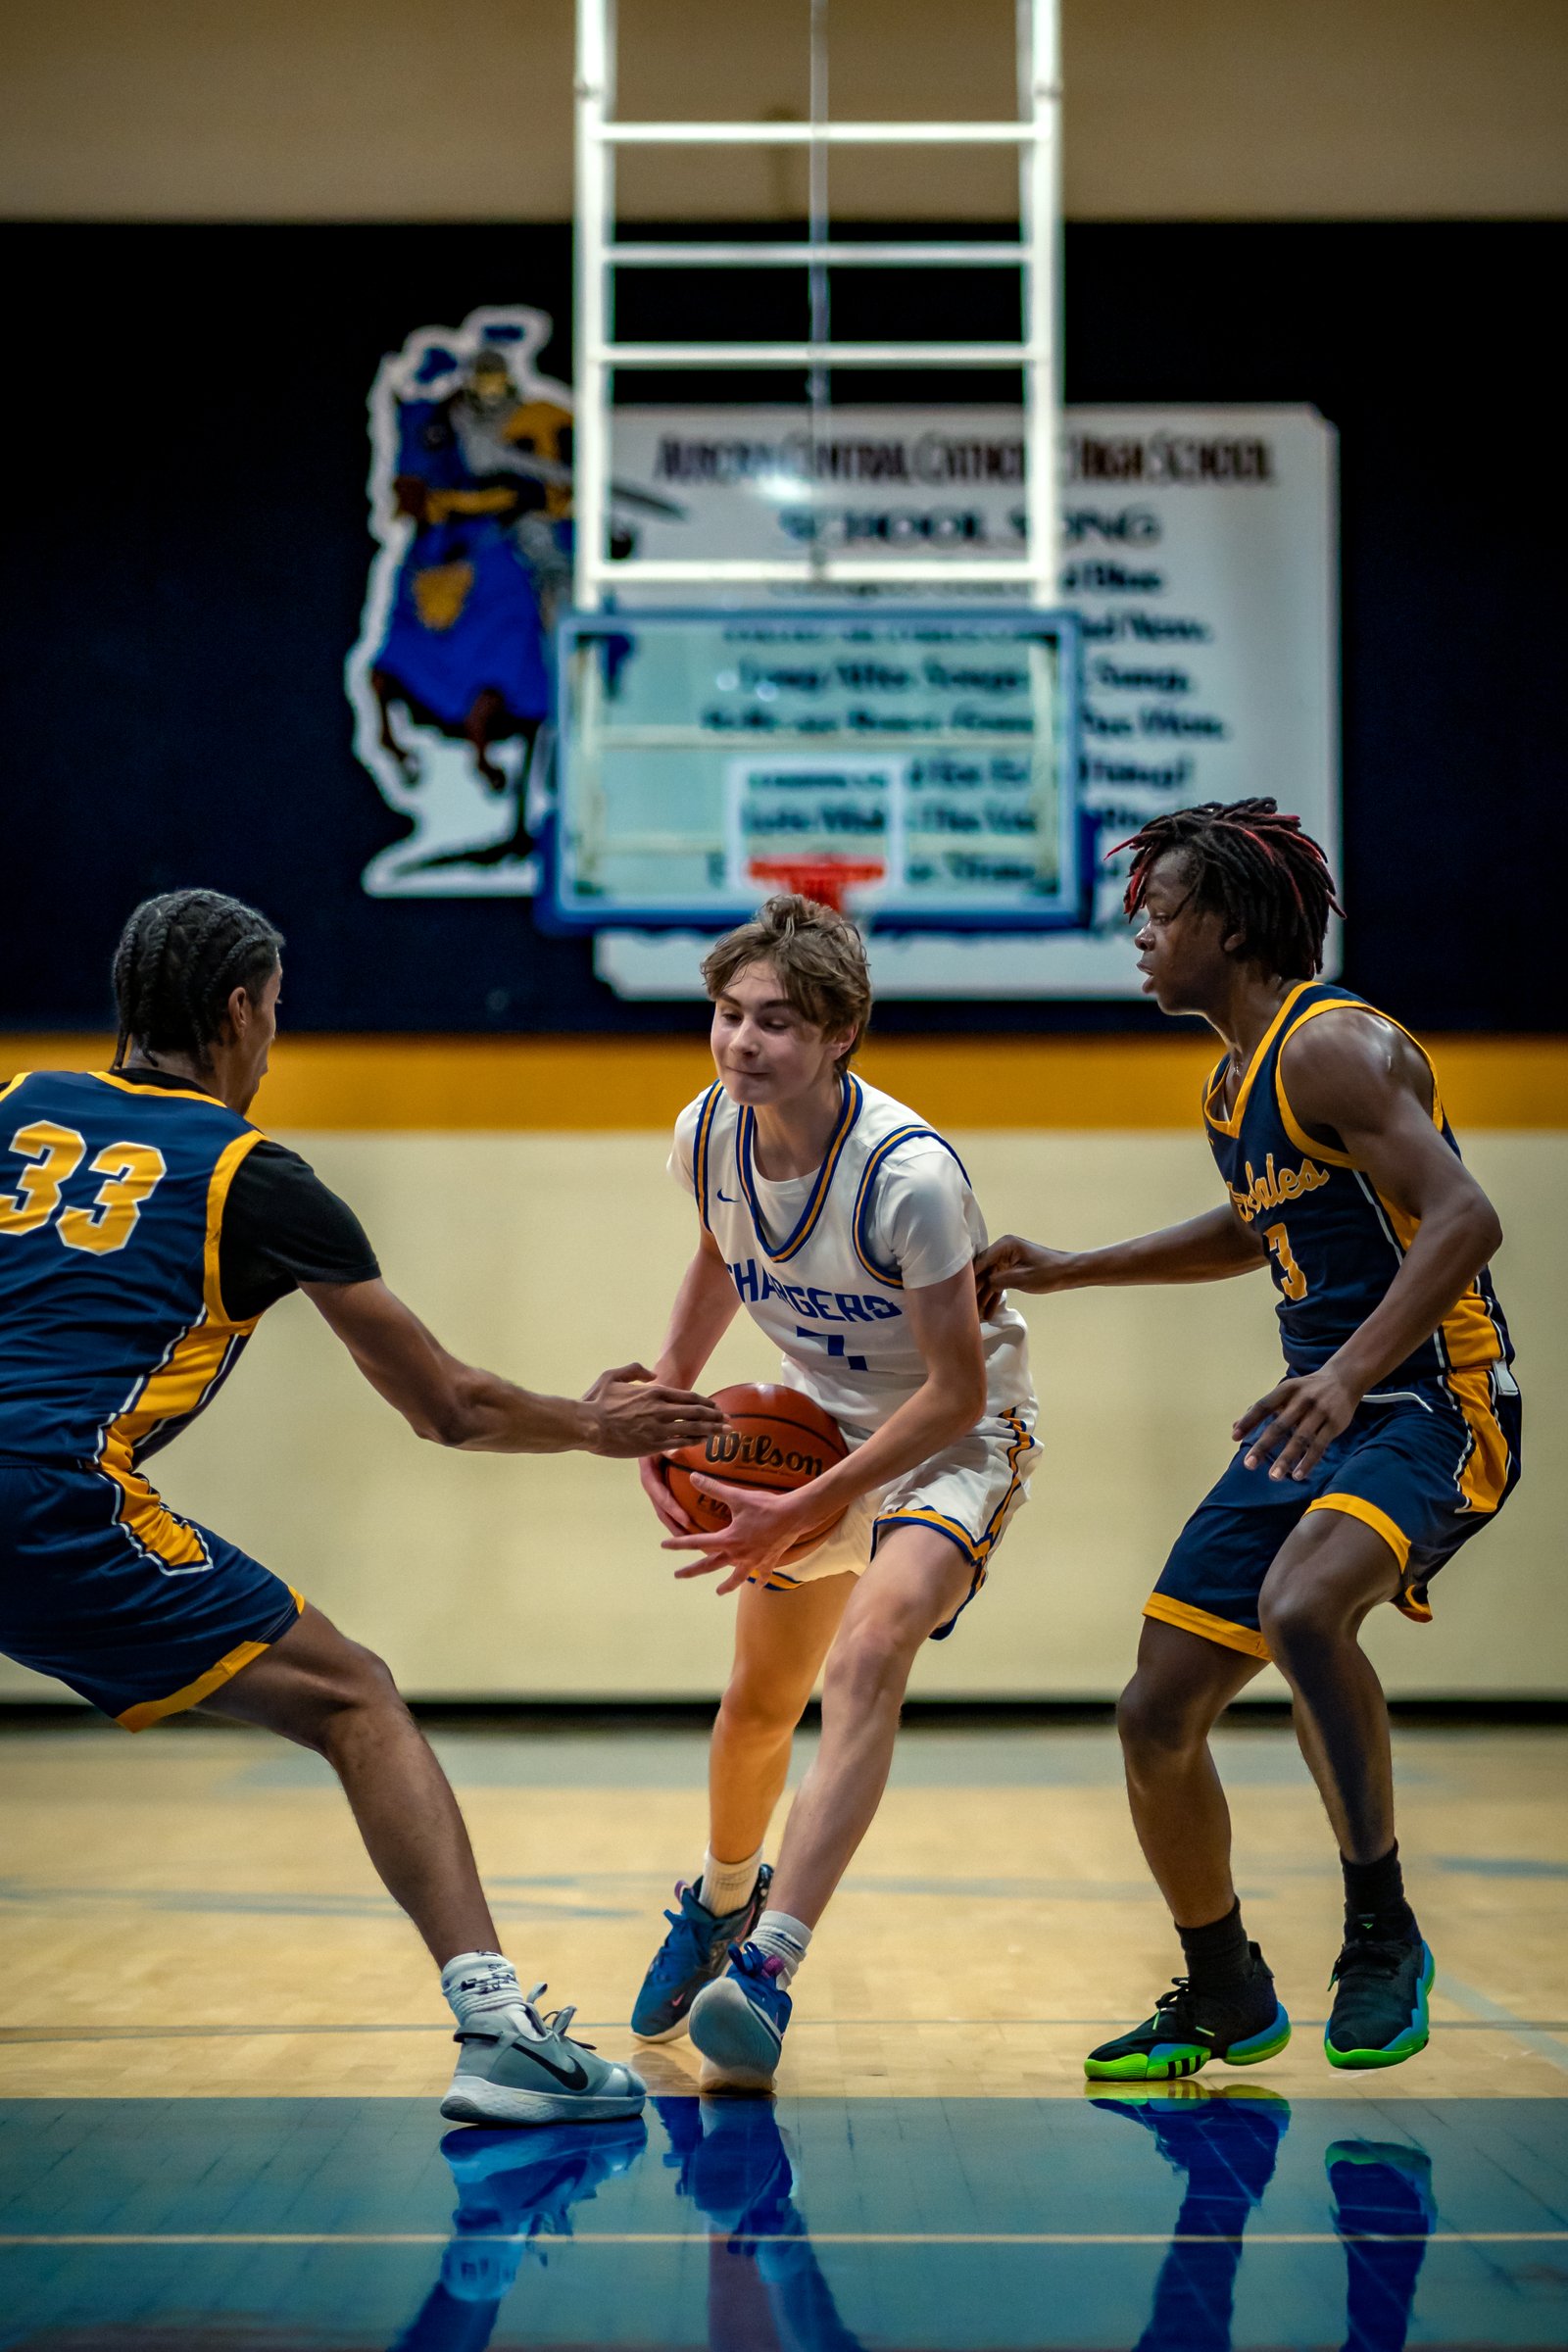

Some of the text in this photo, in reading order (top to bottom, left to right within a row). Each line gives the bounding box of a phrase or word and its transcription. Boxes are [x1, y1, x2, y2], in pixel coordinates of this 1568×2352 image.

[1147, 429, 1275, 484] SCHOOL
[0, 1120, 167, 1255] 33
[726, 1258, 903, 1323] HARGERS
[1262, 1222, 1308, 1301] 3
[705, 1431, 823, 1478] Wilson
